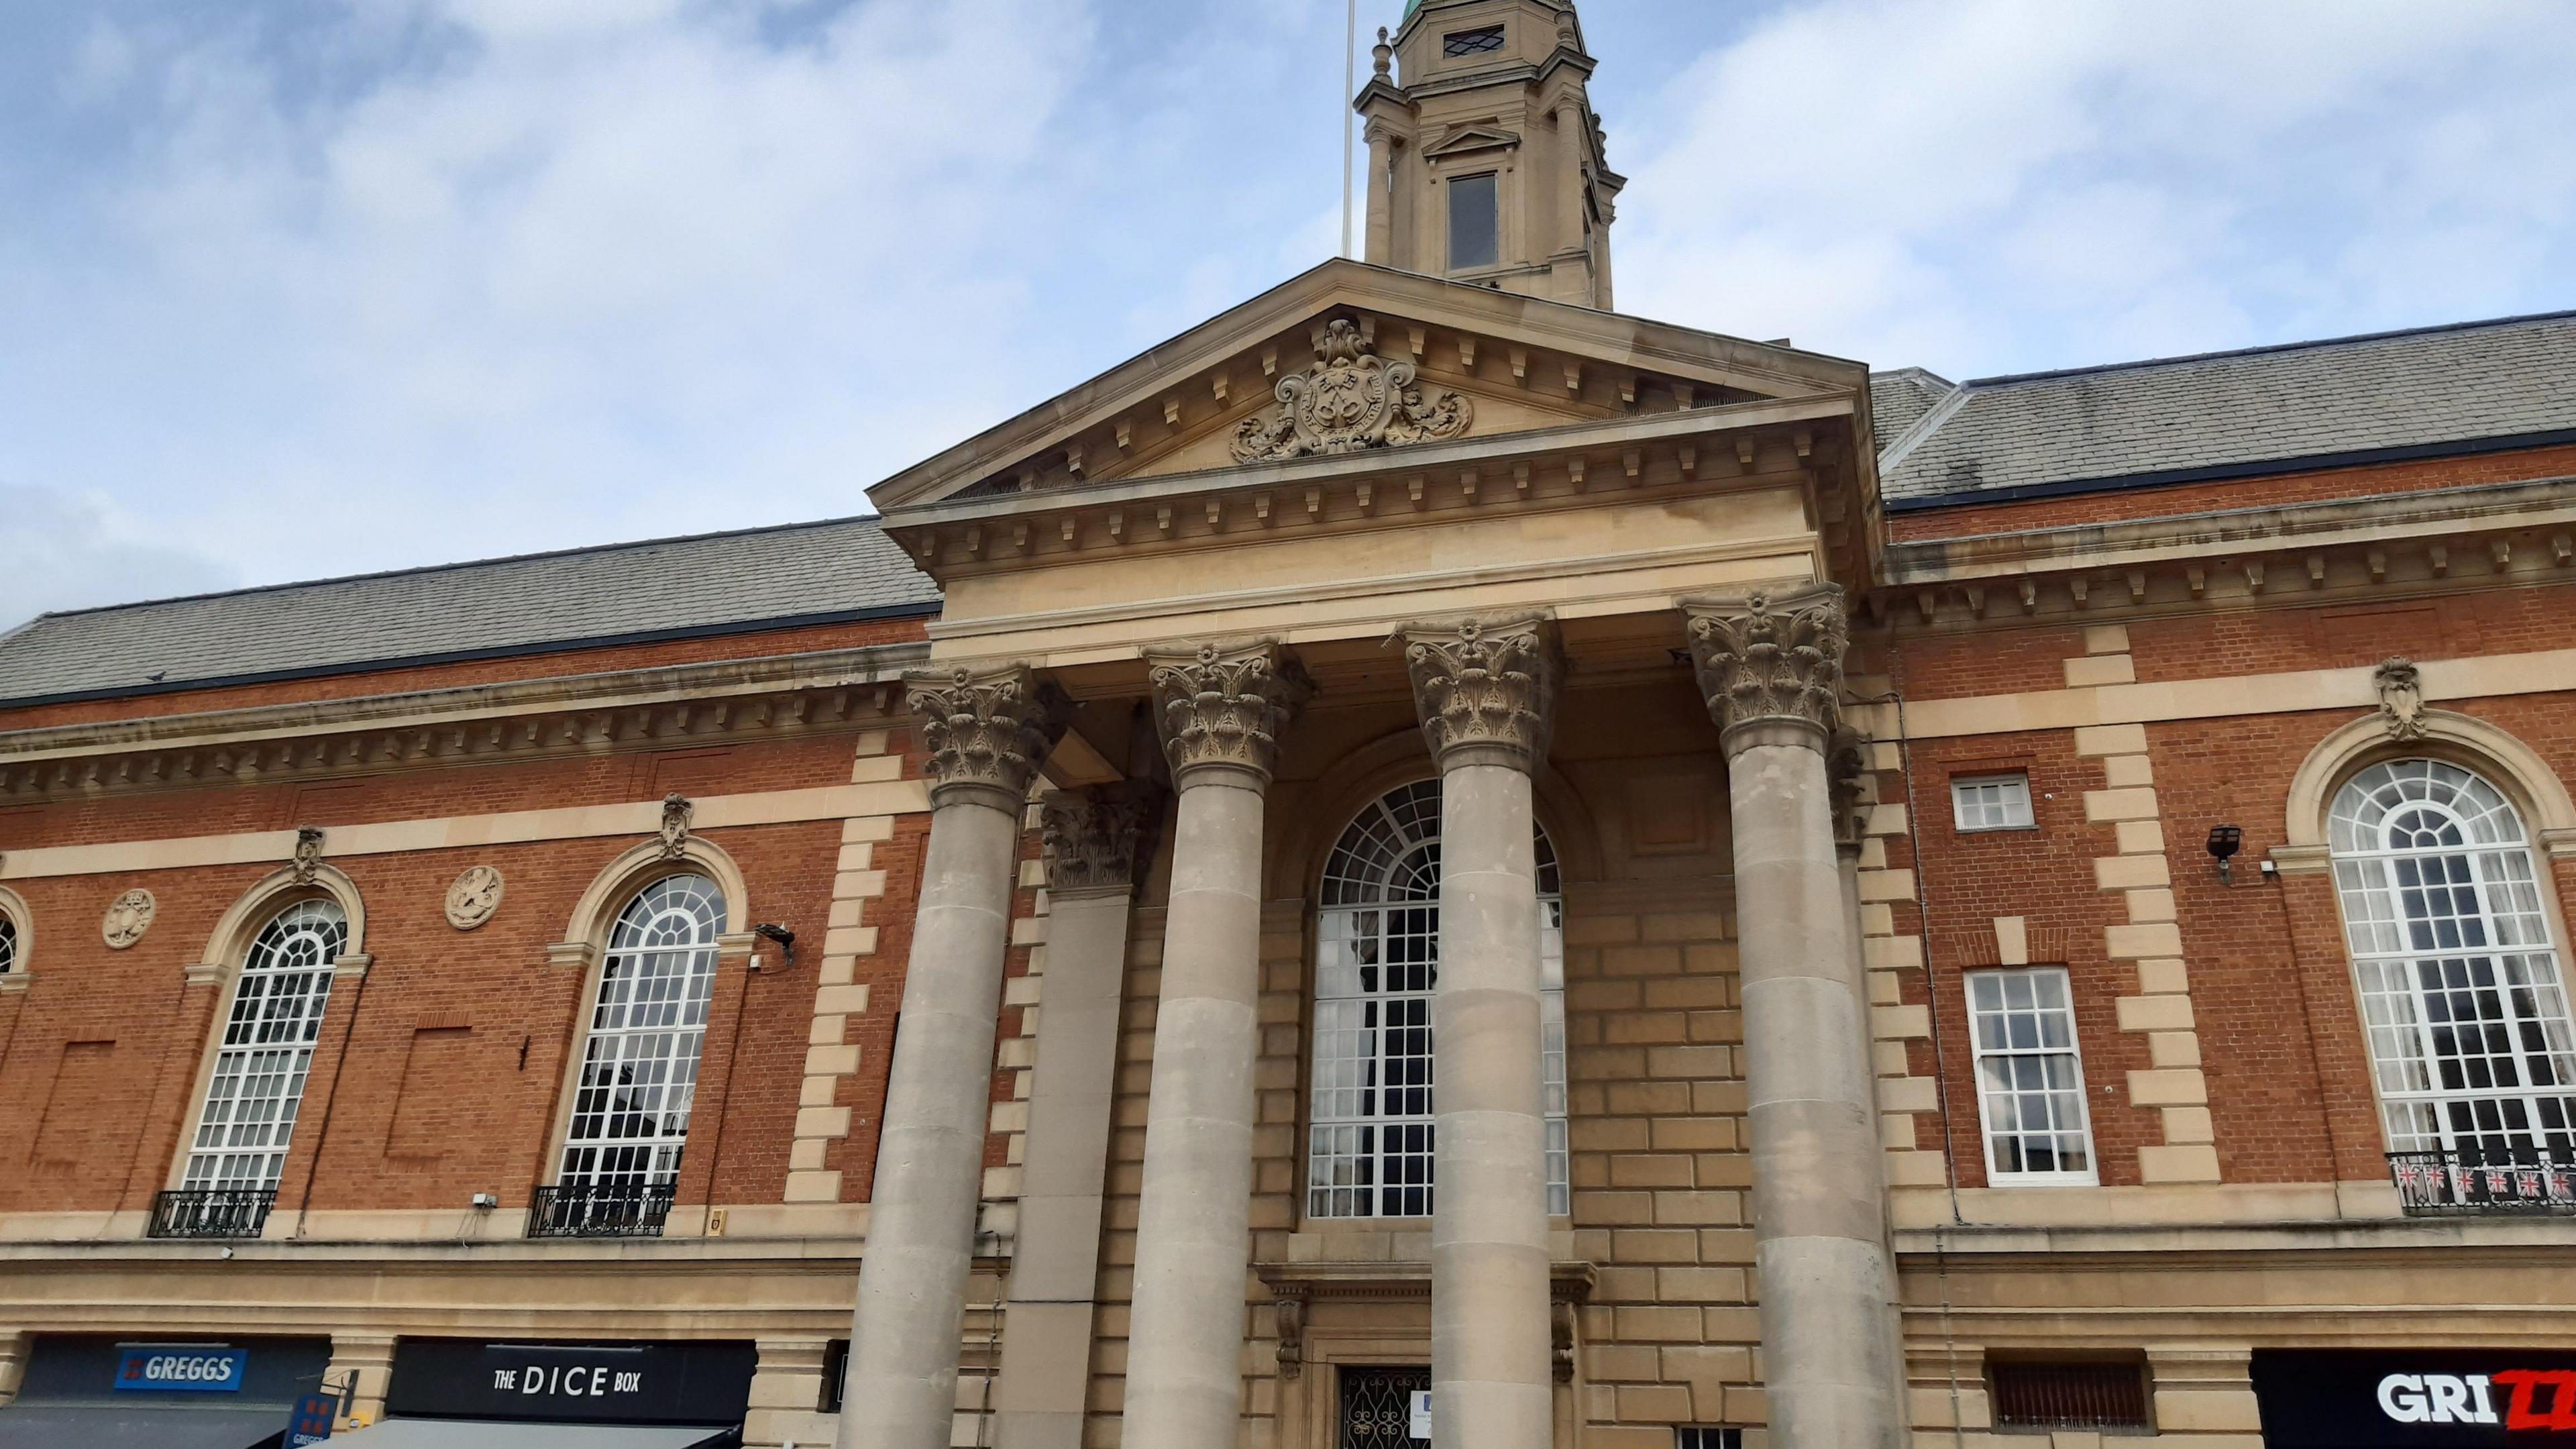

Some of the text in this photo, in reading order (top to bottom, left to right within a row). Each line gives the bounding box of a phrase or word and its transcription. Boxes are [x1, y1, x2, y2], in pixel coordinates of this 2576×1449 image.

[145, 1356, 234, 1381] GREGGS
[494, 1366, 641, 1396] THE DICE BOX
